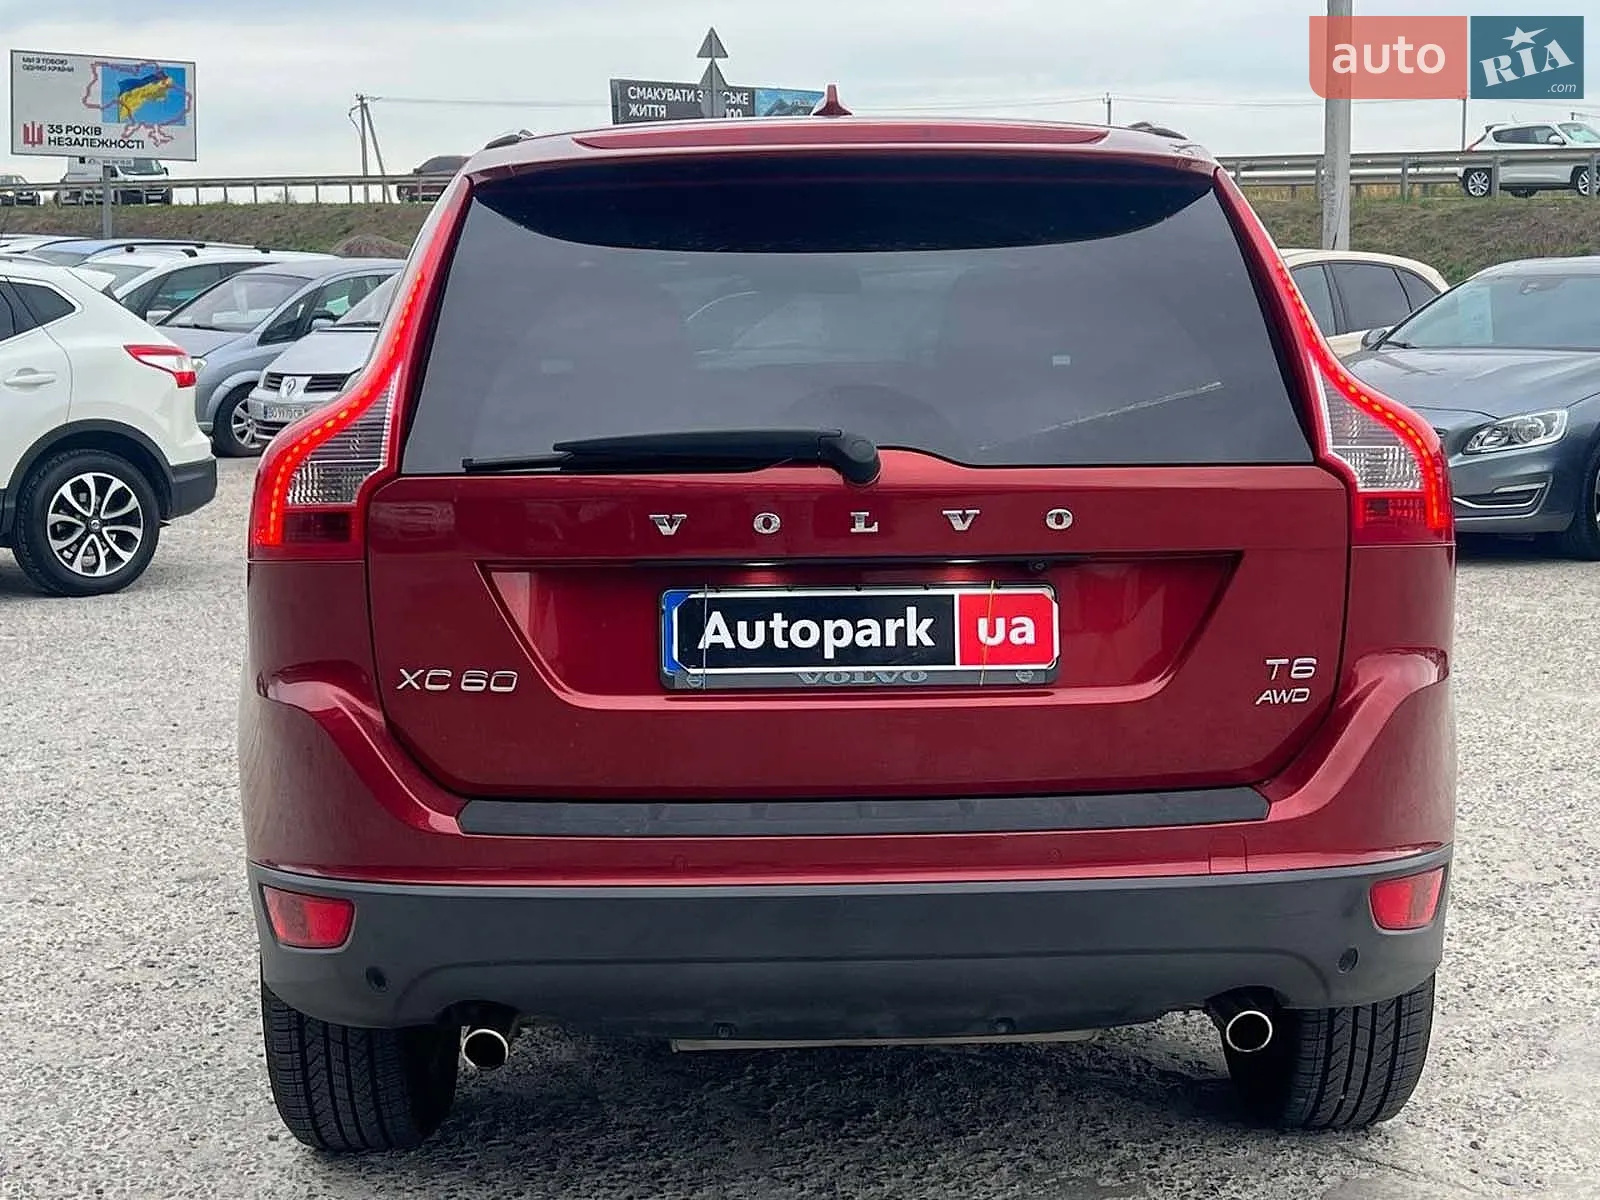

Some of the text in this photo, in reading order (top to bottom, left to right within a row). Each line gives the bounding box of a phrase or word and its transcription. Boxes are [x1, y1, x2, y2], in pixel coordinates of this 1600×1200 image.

[627, 86, 695, 103] СМАКУВАТИ
[628, 102, 667, 118] ЖИТТЯ
[47, 124, 102, 136] 35 РОКІВ
[48, 137, 145, 150] НЕЗАЛЕЖНОСТІ
[649, 508, 1074, 536] VOLVO
[697, 606, 1036, 660] Autopark ua
[797, 670, 929, 684] VOLVO
[1265, 657, 1317, 680] T6
[1255, 687, 1310, 705] AWD
